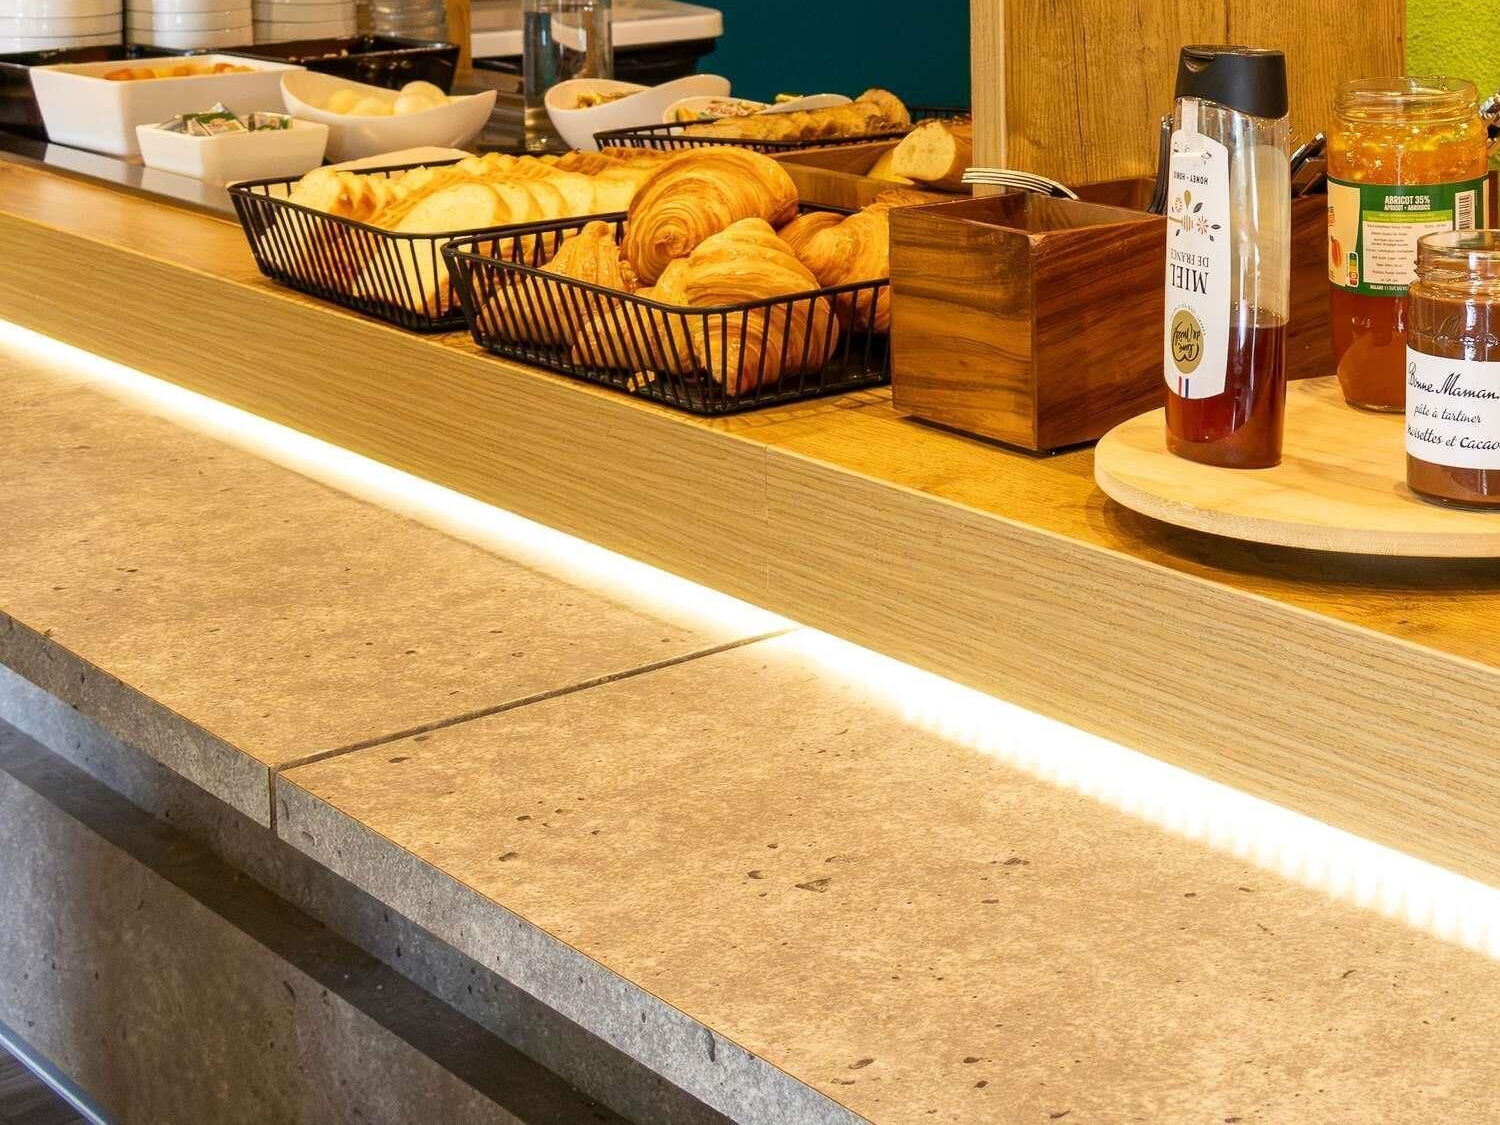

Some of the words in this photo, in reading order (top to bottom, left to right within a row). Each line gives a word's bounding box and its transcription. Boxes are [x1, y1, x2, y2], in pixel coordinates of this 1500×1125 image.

[1384, 195, 1414, 205] ABRICOT
[1197, 255, 1209, 268] DE
[1169, 263, 1210, 295] MIEL
[1441, 408, 1481, 423] tartiner
[1445, 435, 1456, 447] et
